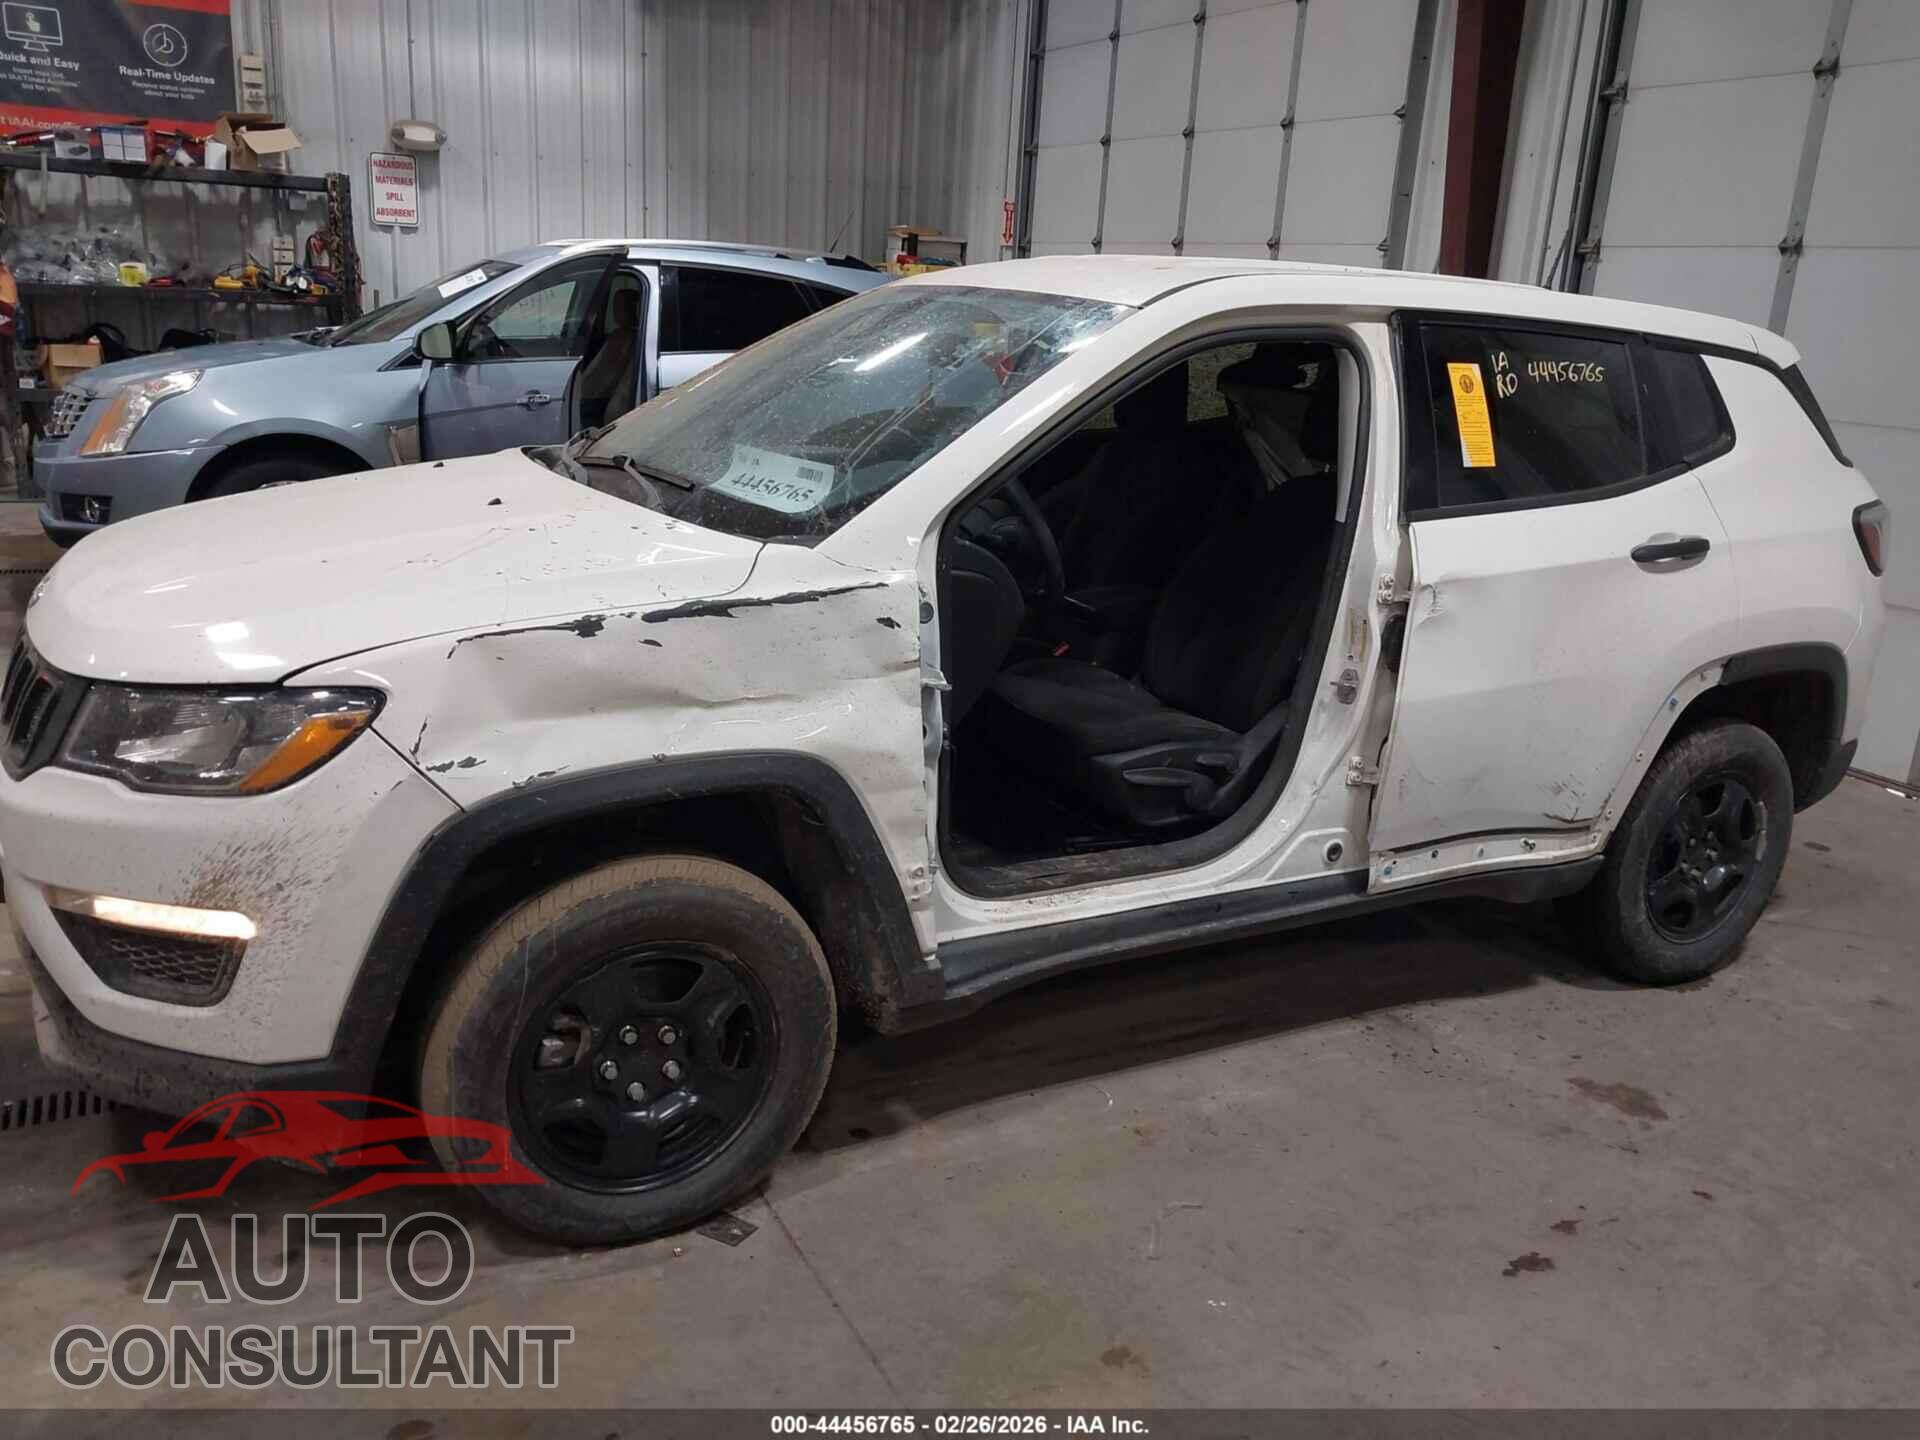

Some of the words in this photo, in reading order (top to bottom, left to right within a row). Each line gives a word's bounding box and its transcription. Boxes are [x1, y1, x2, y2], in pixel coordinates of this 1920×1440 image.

[30, 56, 51, 66] and
[54, 57, 80, 71] Easy
[119, 64, 172, 80] Real-Time
[174, 71, 215, 84] Updates
[373, 159, 414, 170] HAZARDOUS
[375, 175, 414, 186] MATERIALS
[386, 192, 405, 201] SPILL
[376, 207, 415, 217] ABSORBENT
[1528, 360, 1605, 384] 44456765
[731, 472, 815, 502] 44456765
